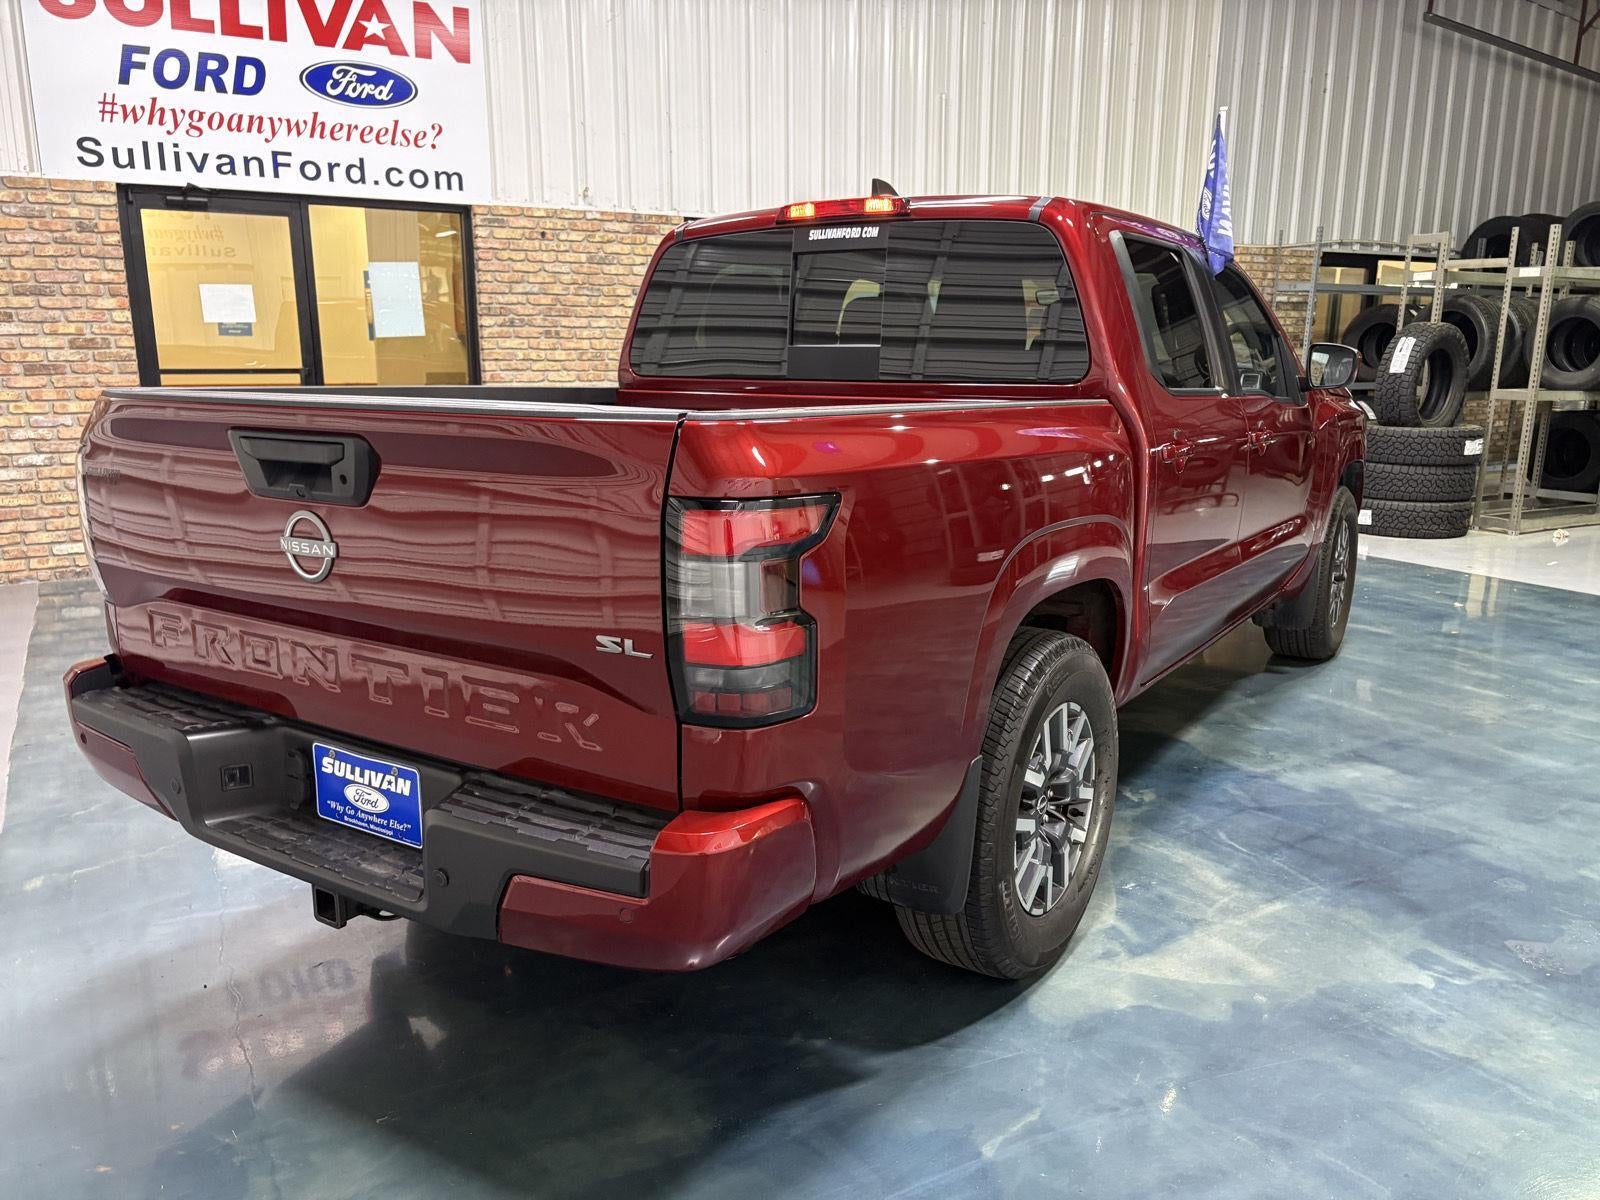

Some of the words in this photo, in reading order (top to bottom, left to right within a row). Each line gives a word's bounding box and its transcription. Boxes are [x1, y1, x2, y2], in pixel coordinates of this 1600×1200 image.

[117, 44, 266, 96] FORD
[325, 66, 395, 101] Ford
[98, 92, 444, 150] #whygoanywhereelse?
[76, 136, 465, 192] SullivanFord.com
[280, 537, 334, 556] NISSAN
[595, 634, 654, 660] SL
[147, 608, 603, 752] FRONTIER
[321, 756, 412, 797] SULLIVAN
[345, 805, 355, 816] Go
[355, 810, 388, 826] Anywhere
[353, 788, 380, 809] Ford
